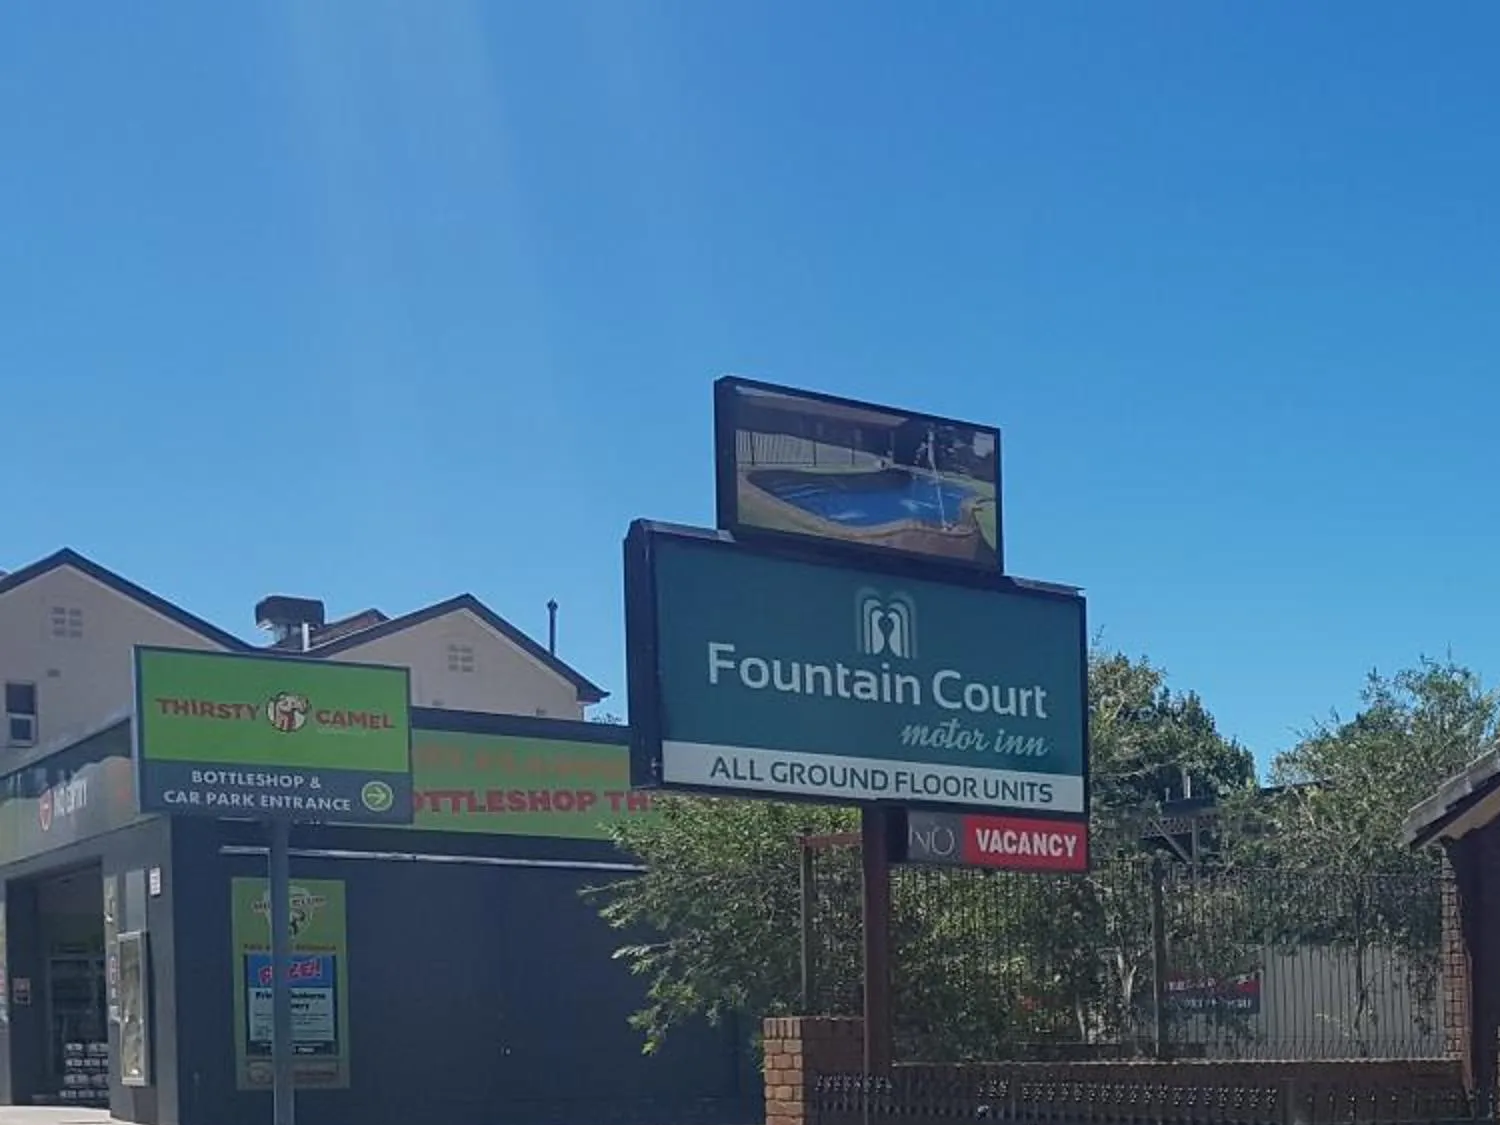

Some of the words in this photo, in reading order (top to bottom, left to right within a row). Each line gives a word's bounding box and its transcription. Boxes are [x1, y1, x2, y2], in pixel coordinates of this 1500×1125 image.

[708, 641, 920, 706] Fountain
[932, 669, 1048, 719] Court
[154, 698, 260, 721] THIRSTY
[315, 709, 395, 730] CAMEL
[900, 718, 991, 753] motor
[994, 728, 1053, 757] inn
[191, 770, 305, 790] BOTTLESHOP
[311, 776, 321, 790] &
[710, 756, 763, 782] ALL
[770, 760, 889, 792] GROUND
[895, 771, 977, 798] FLOOR
[983, 778, 1053, 804] UNITS
[163, 790, 201, 805] CAR
[206, 791, 255, 808] PARK
[260, 794, 351, 812] ENTRANCE
[908, 824, 955, 856] NO
[975, 827, 1078, 859] VACANCY
